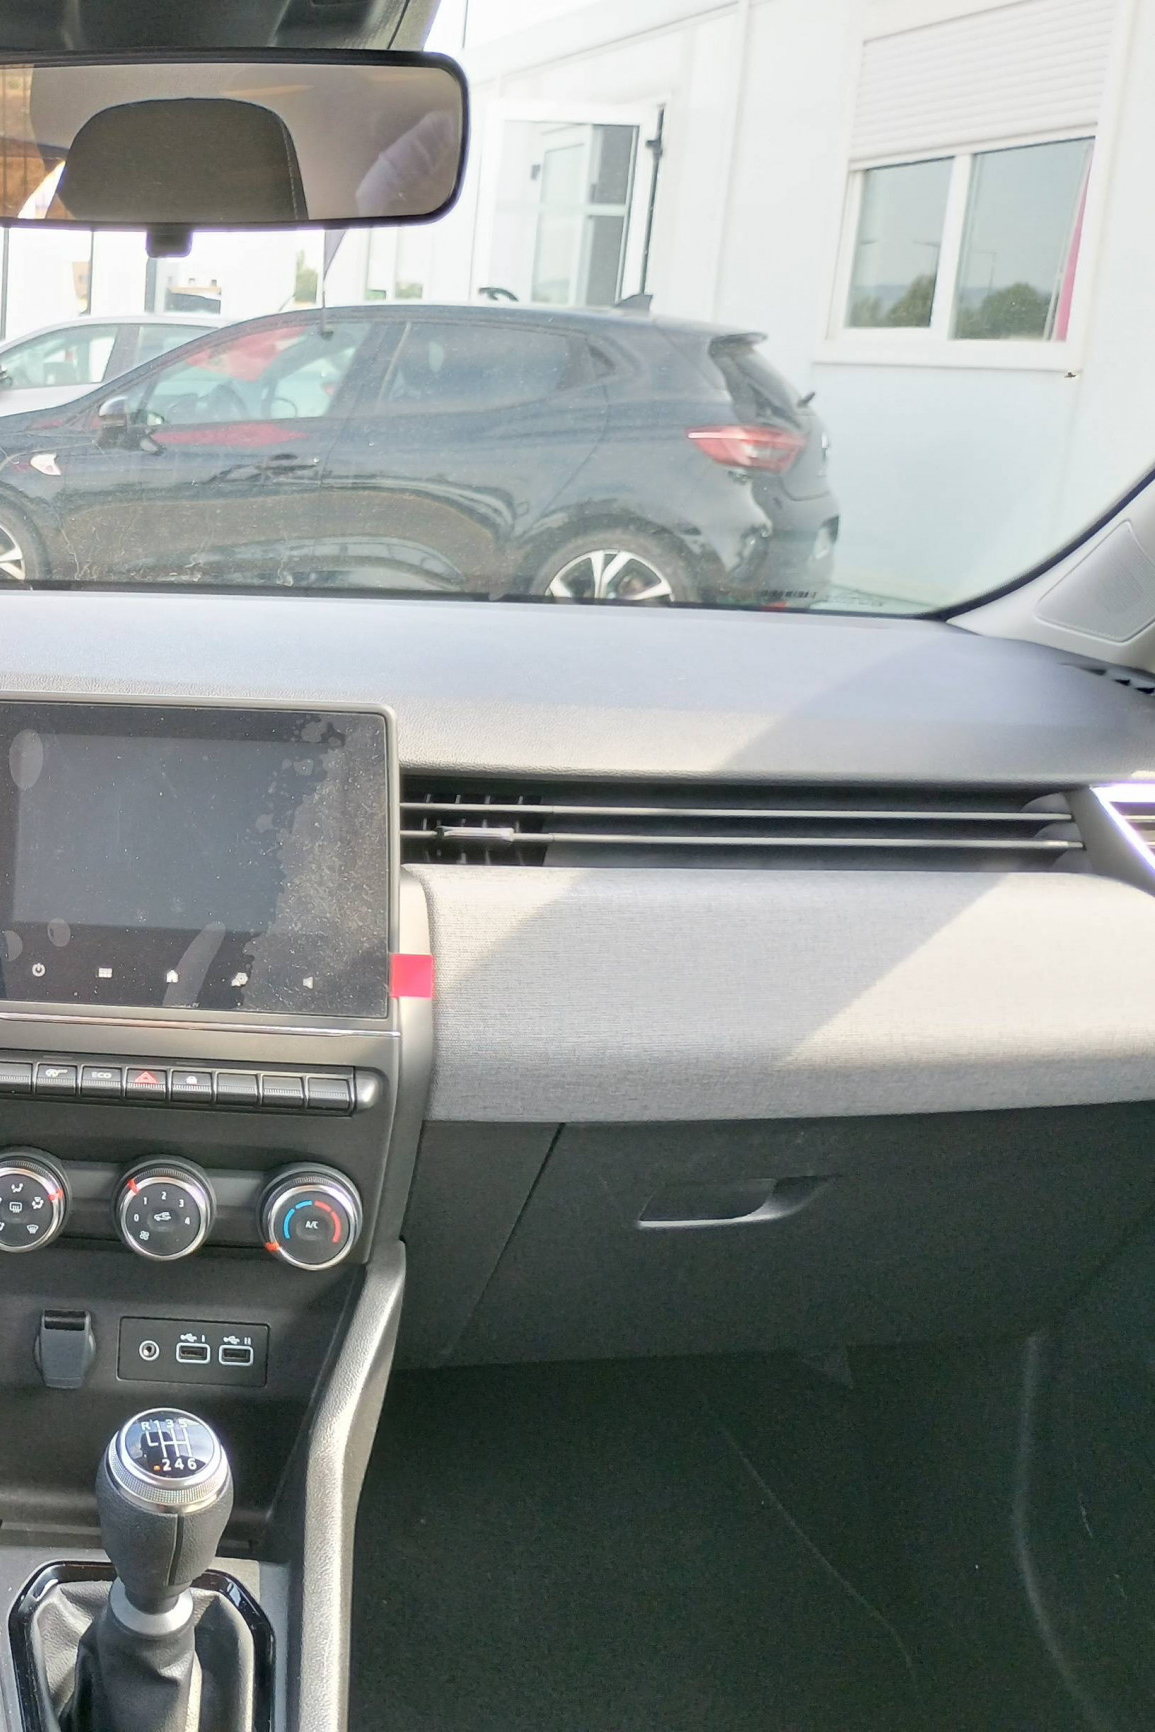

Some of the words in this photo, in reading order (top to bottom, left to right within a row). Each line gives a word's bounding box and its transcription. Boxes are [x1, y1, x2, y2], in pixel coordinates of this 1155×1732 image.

[91, 1071, 112, 1079] ECO
[161, 1191, 167, 1200] 2
[143, 1197, 148, 1205] 1
[178, 1199, 185, 1208] 3
[133, 1213, 140, 1222] 0
[184, 1216, 191, 1225] 4
[141, 1421, 151, 1430] R
[165, 1419, 174, 1428] 3
[162, 1459, 172, 1471] 2
[174, 1458, 185, 1470] 4
[187, 1458, 197, 1470] 6
